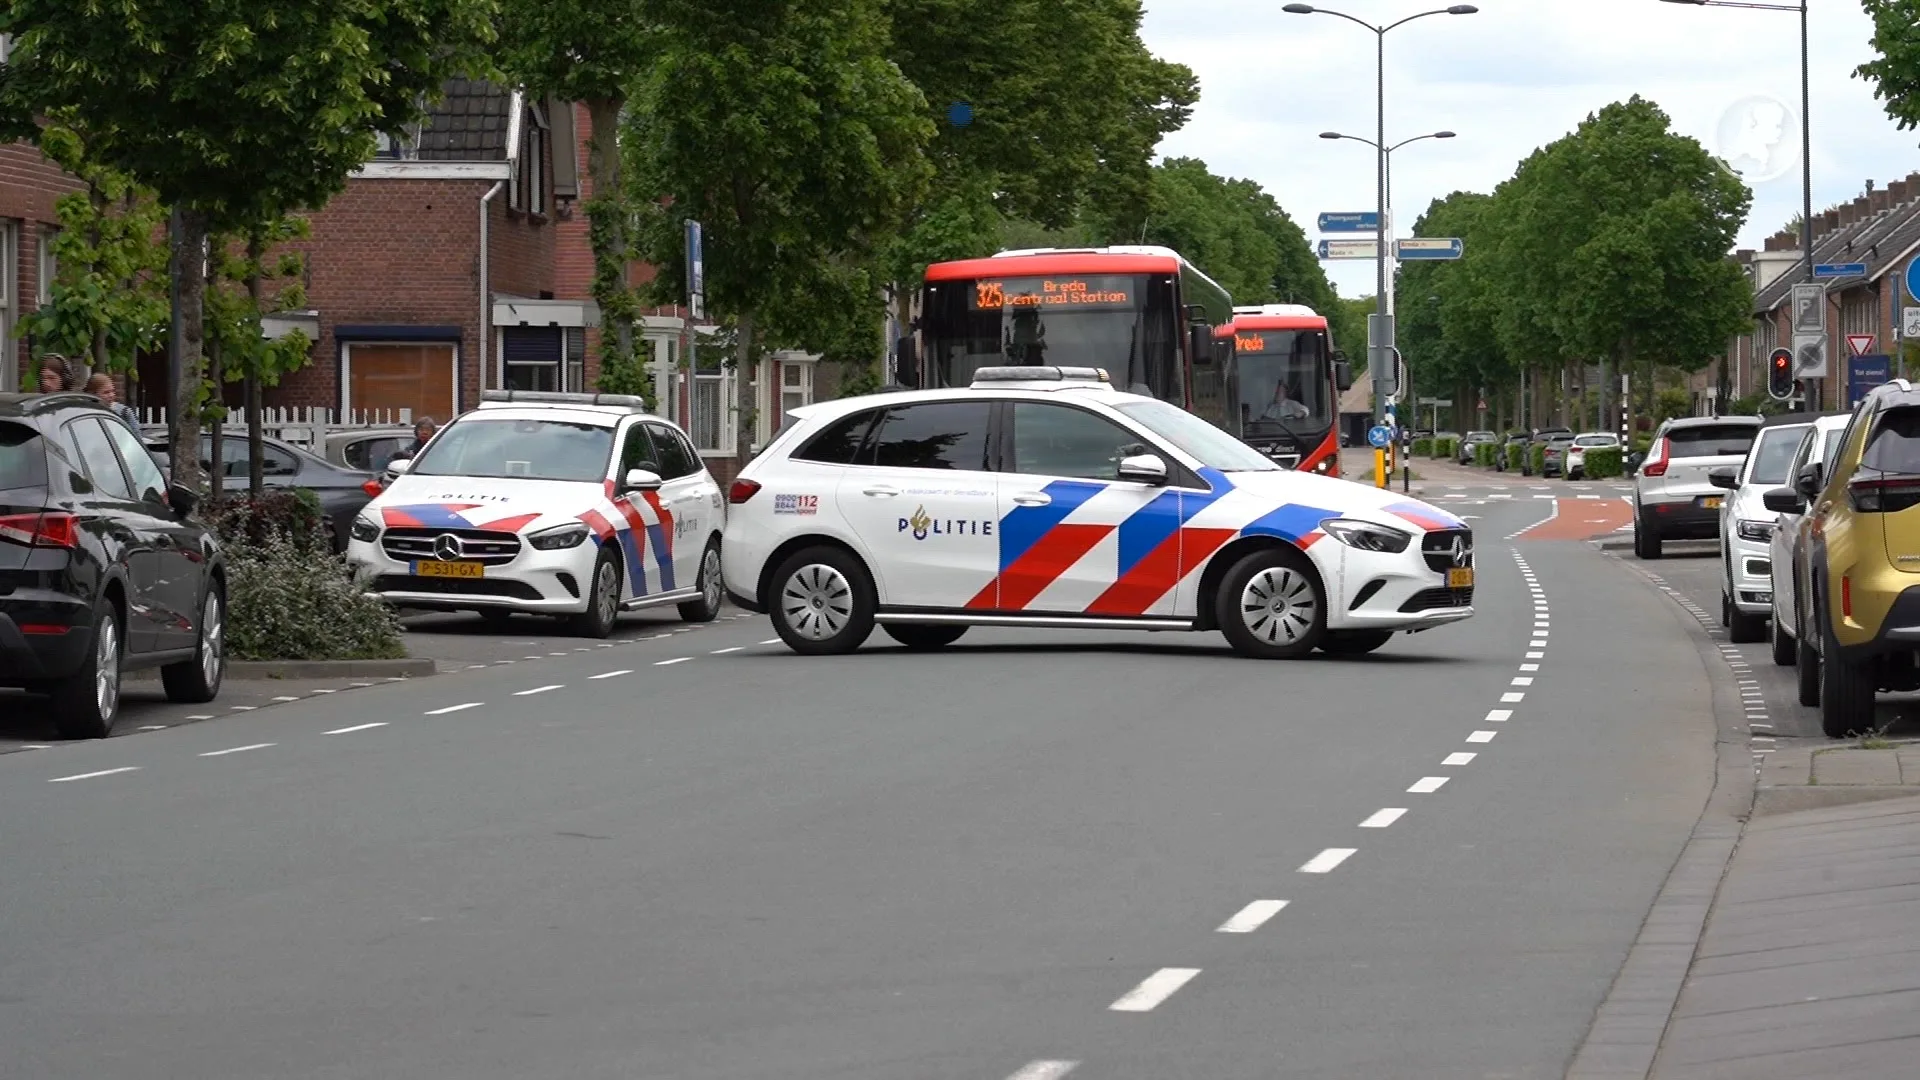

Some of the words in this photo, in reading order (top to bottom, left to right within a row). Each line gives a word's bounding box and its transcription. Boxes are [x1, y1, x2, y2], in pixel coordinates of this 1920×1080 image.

[1043, 280, 1087, 292] Breda
[976, 282, 1003, 308] 325
[1004, 292, 1068, 305] Centraal
[1070, 290, 1126, 303] Station
[797, 495, 818, 507] 112
[898, 518, 993, 541] POLITIE
[421, 563, 477, 577] P-531-GX
